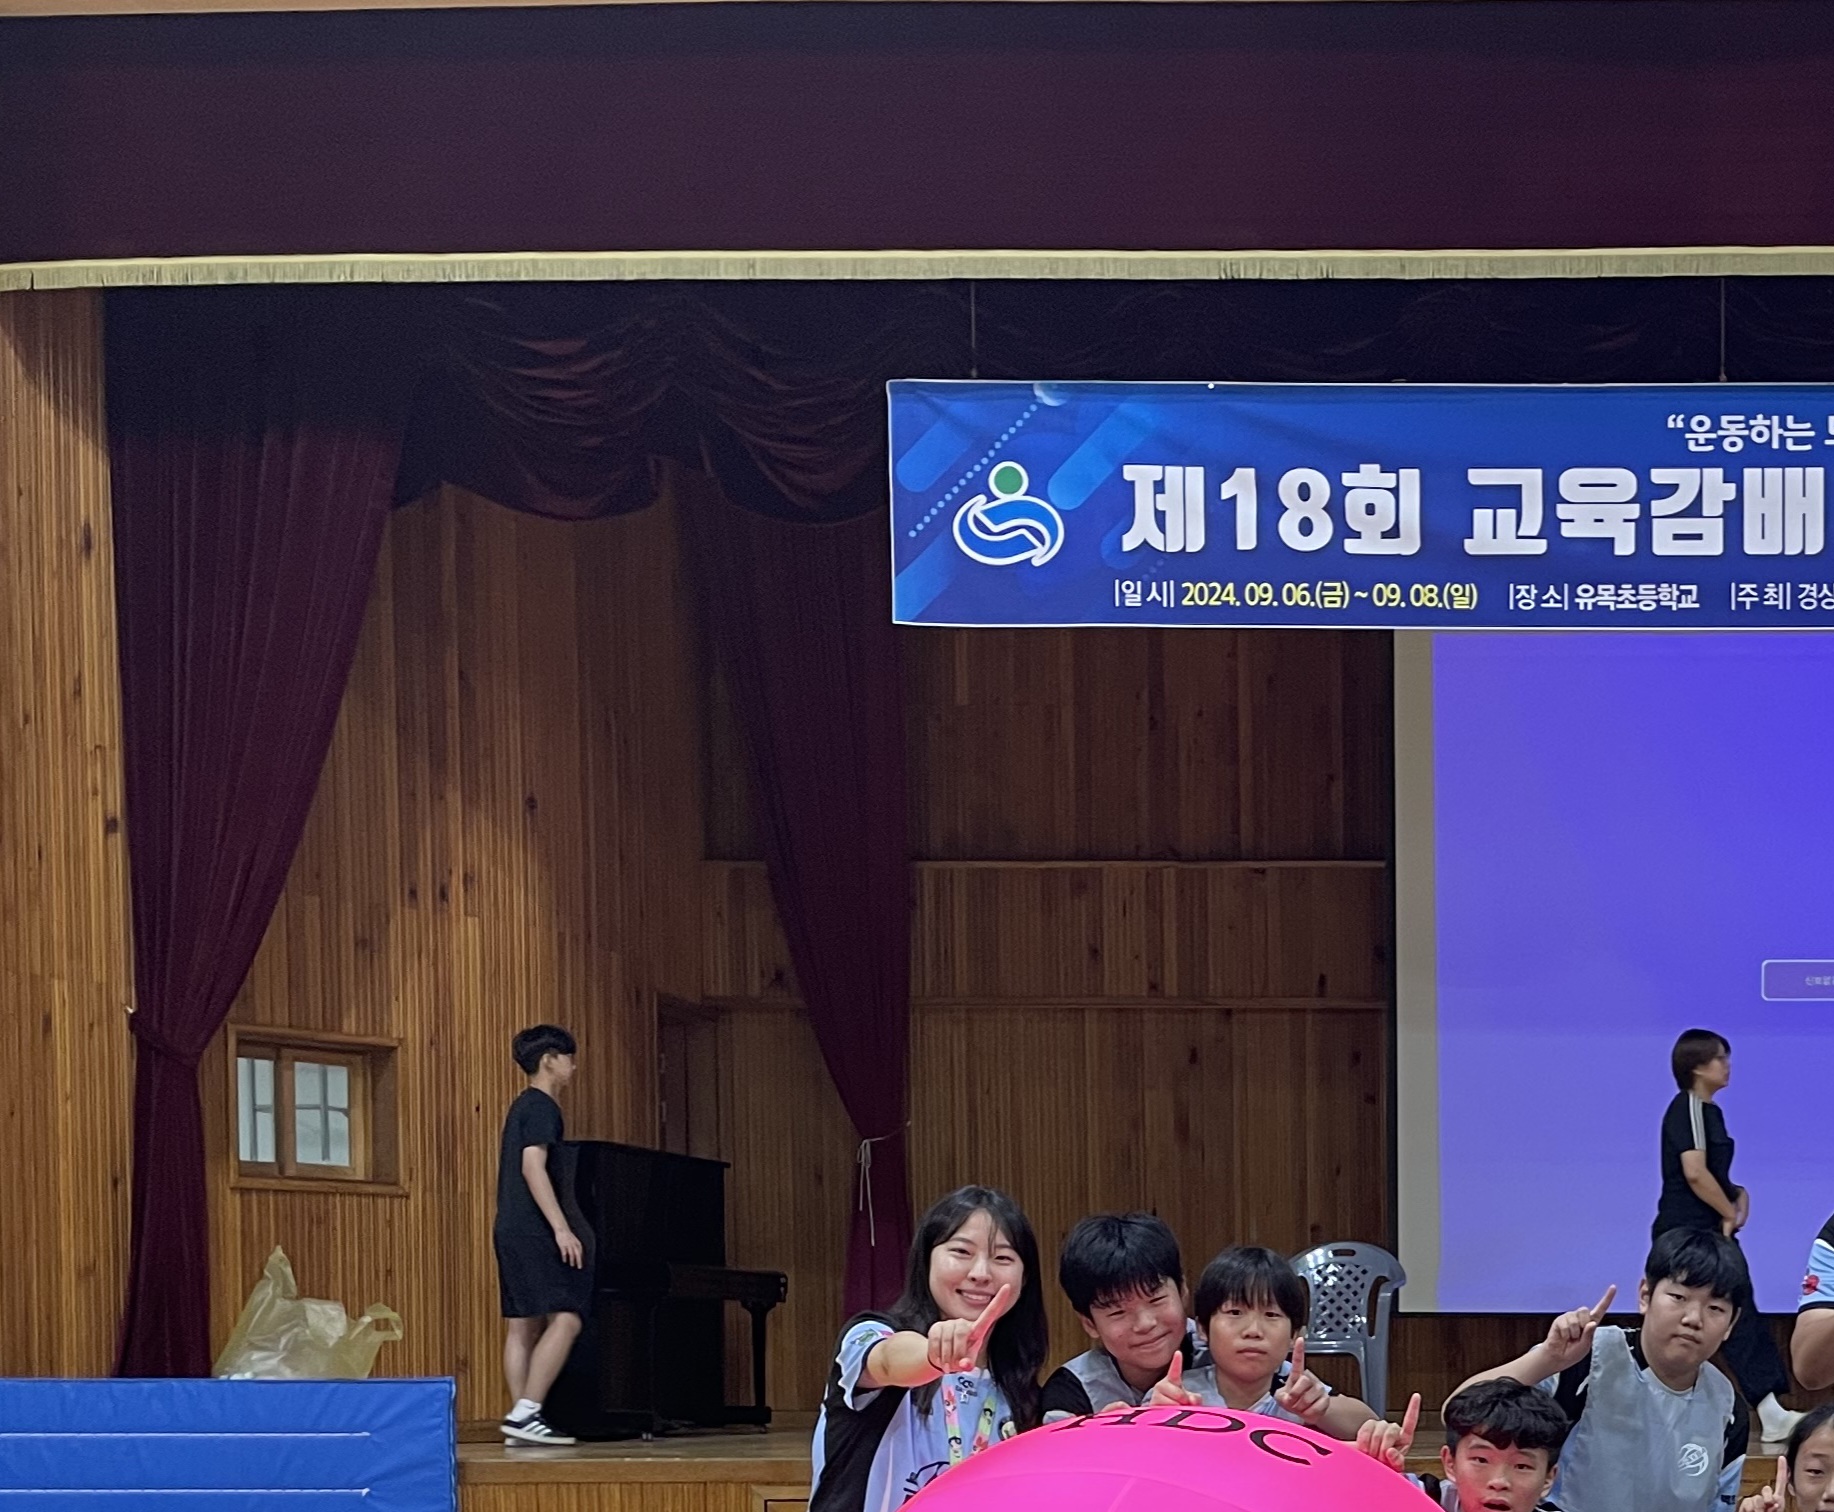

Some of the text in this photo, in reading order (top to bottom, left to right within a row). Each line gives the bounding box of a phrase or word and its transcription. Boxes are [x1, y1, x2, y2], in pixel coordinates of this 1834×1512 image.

[1121, 463, 1421, 556] 제18회
[1463, 466, 1825, 556] 교육감배
[1574, 583, 1701, 611] 유목초등학교
